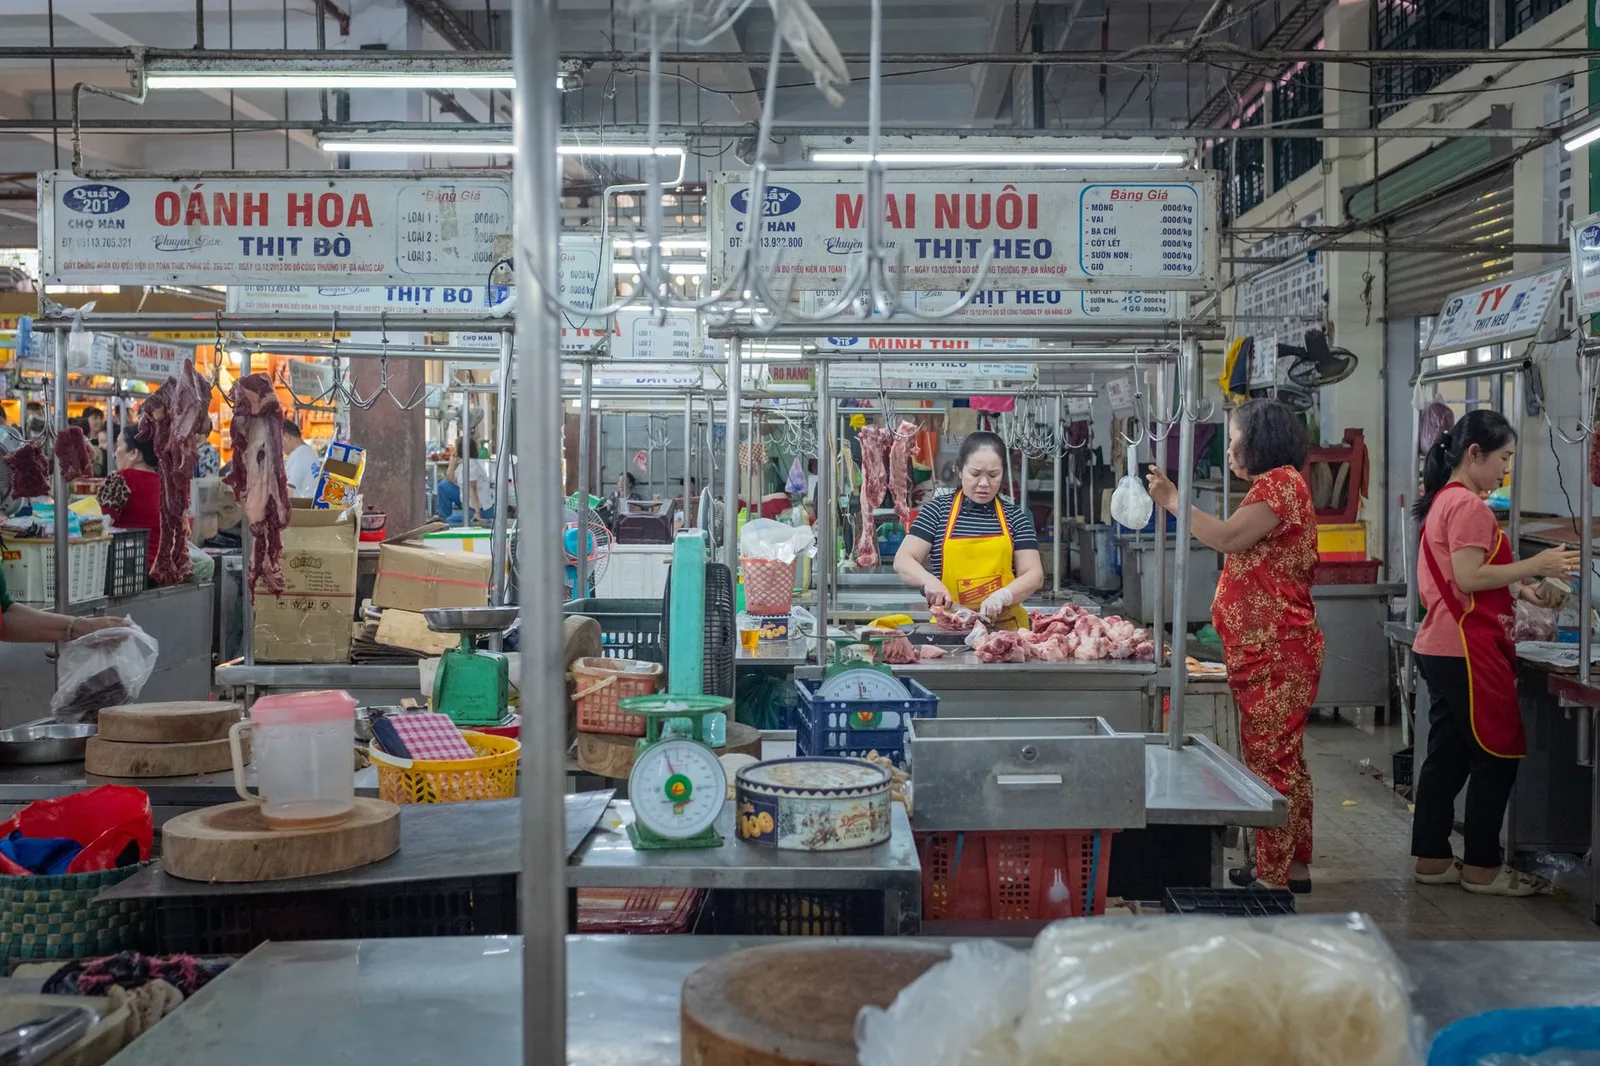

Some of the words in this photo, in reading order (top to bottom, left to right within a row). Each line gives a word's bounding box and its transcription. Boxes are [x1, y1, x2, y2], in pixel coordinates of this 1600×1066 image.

[1110, 189, 1143, 202] Bảng
[1147, 188, 1169, 200] Giá
[82, 199, 110, 213] 201
[154, 183, 269, 227] OÁNH
[287, 192, 373, 228] HOA
[758, 200, 781, 215] 20
[934, 184, 1038, 230] NUÔI
[767, 220, 796, 232] HÀN
[1091, 227, 1101, 235] BA
[238, 237, 303, 261] THỊT
[313, 232, 351, 258] BÒ
[914, 238, 982, 263] THỊT
[992, 238, 1053, 259] HEO
[384, 286, 435, 306] THỊT
[1016, 290, 1061, 305] HEO
[868, 338, 922, 349] MINH
